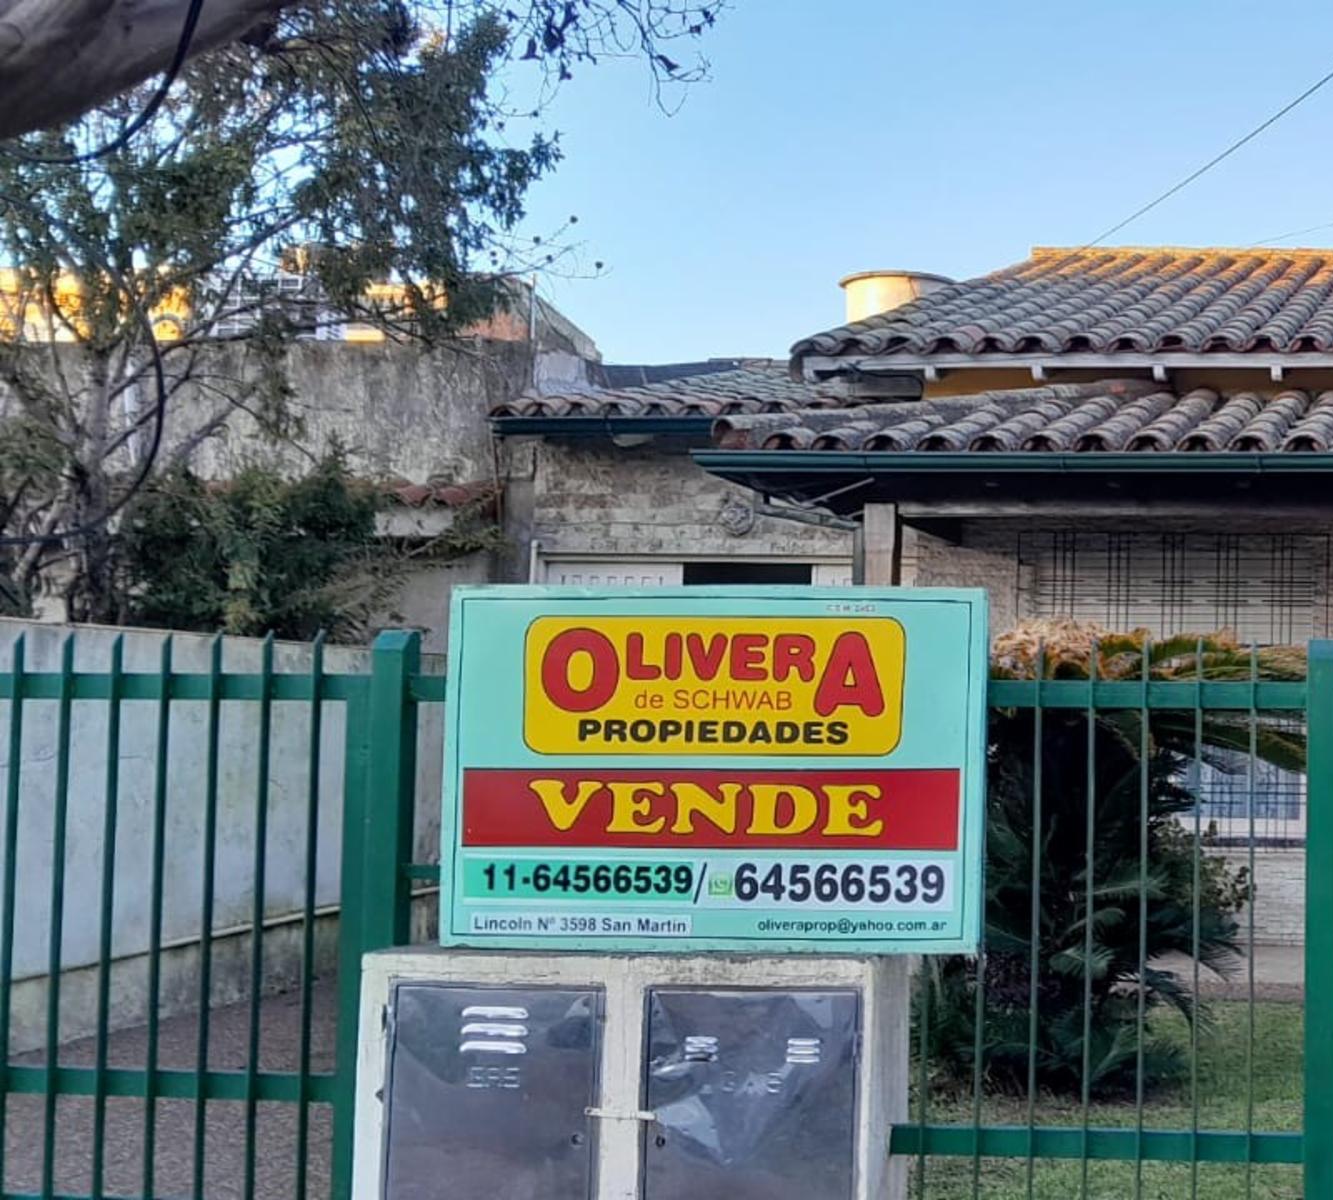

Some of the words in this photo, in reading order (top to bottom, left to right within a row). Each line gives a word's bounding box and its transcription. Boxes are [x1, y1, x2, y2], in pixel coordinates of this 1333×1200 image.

[541, 627, 885, 717] OLIVERA
[634, 690, 664, 709] de
[673, 689, 792, 711] SCHWAB
[578, 719, 850, 744] PROPIEDADES
[528, 779, 884, 837] VENDE
[474, 917, 532, 930] Lincoln
[560, 918, 597, 932] 3598
[602, 919, 631, 932] San
[757, 918, 948, 934] oliveraprop@yahoo.com.ar
